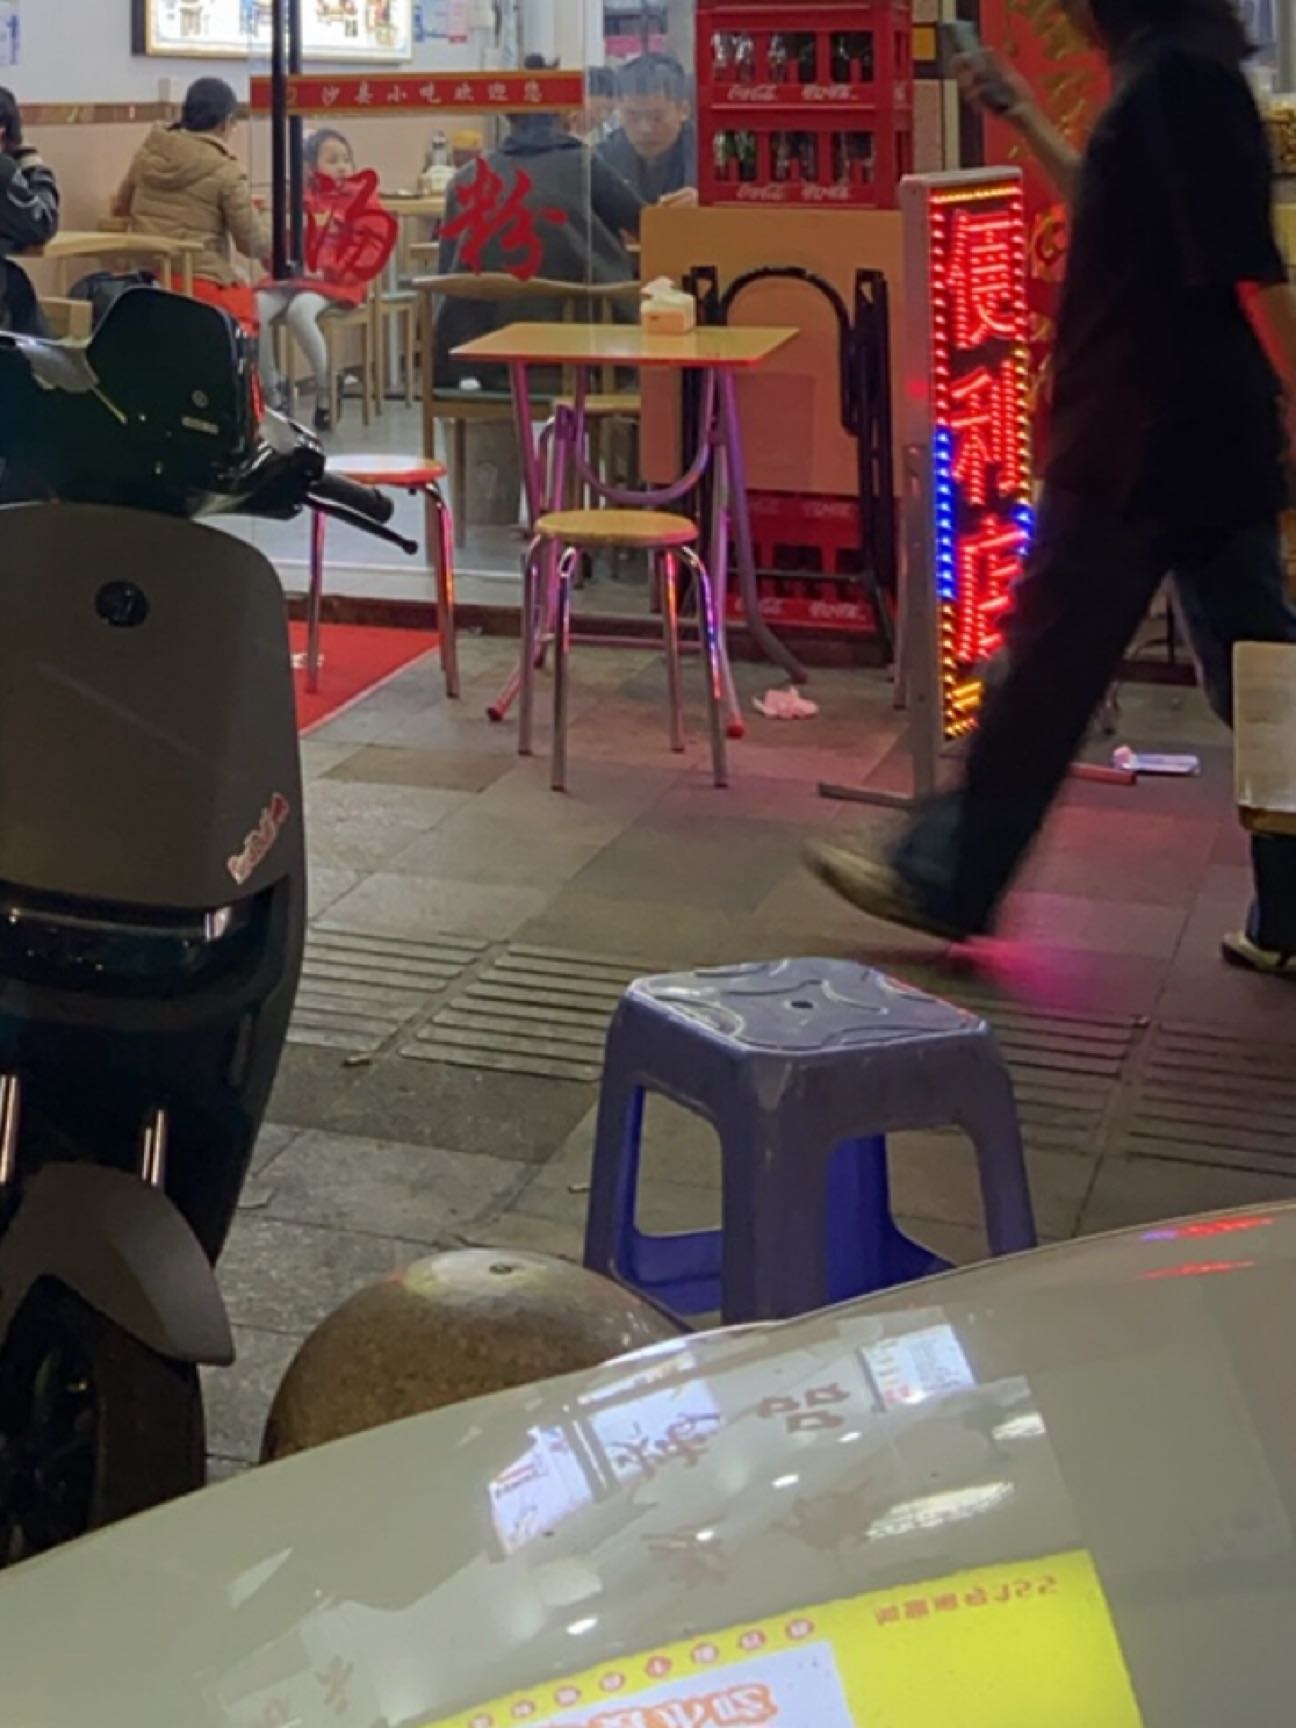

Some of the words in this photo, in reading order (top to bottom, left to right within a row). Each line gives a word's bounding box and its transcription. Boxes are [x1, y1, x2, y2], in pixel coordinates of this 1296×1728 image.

[321, 77, 542, 107] 沙县小吃欢迎您
[304, 151, 568, 282] 汤粉
[948, 208, 1026, 662] 便利店
